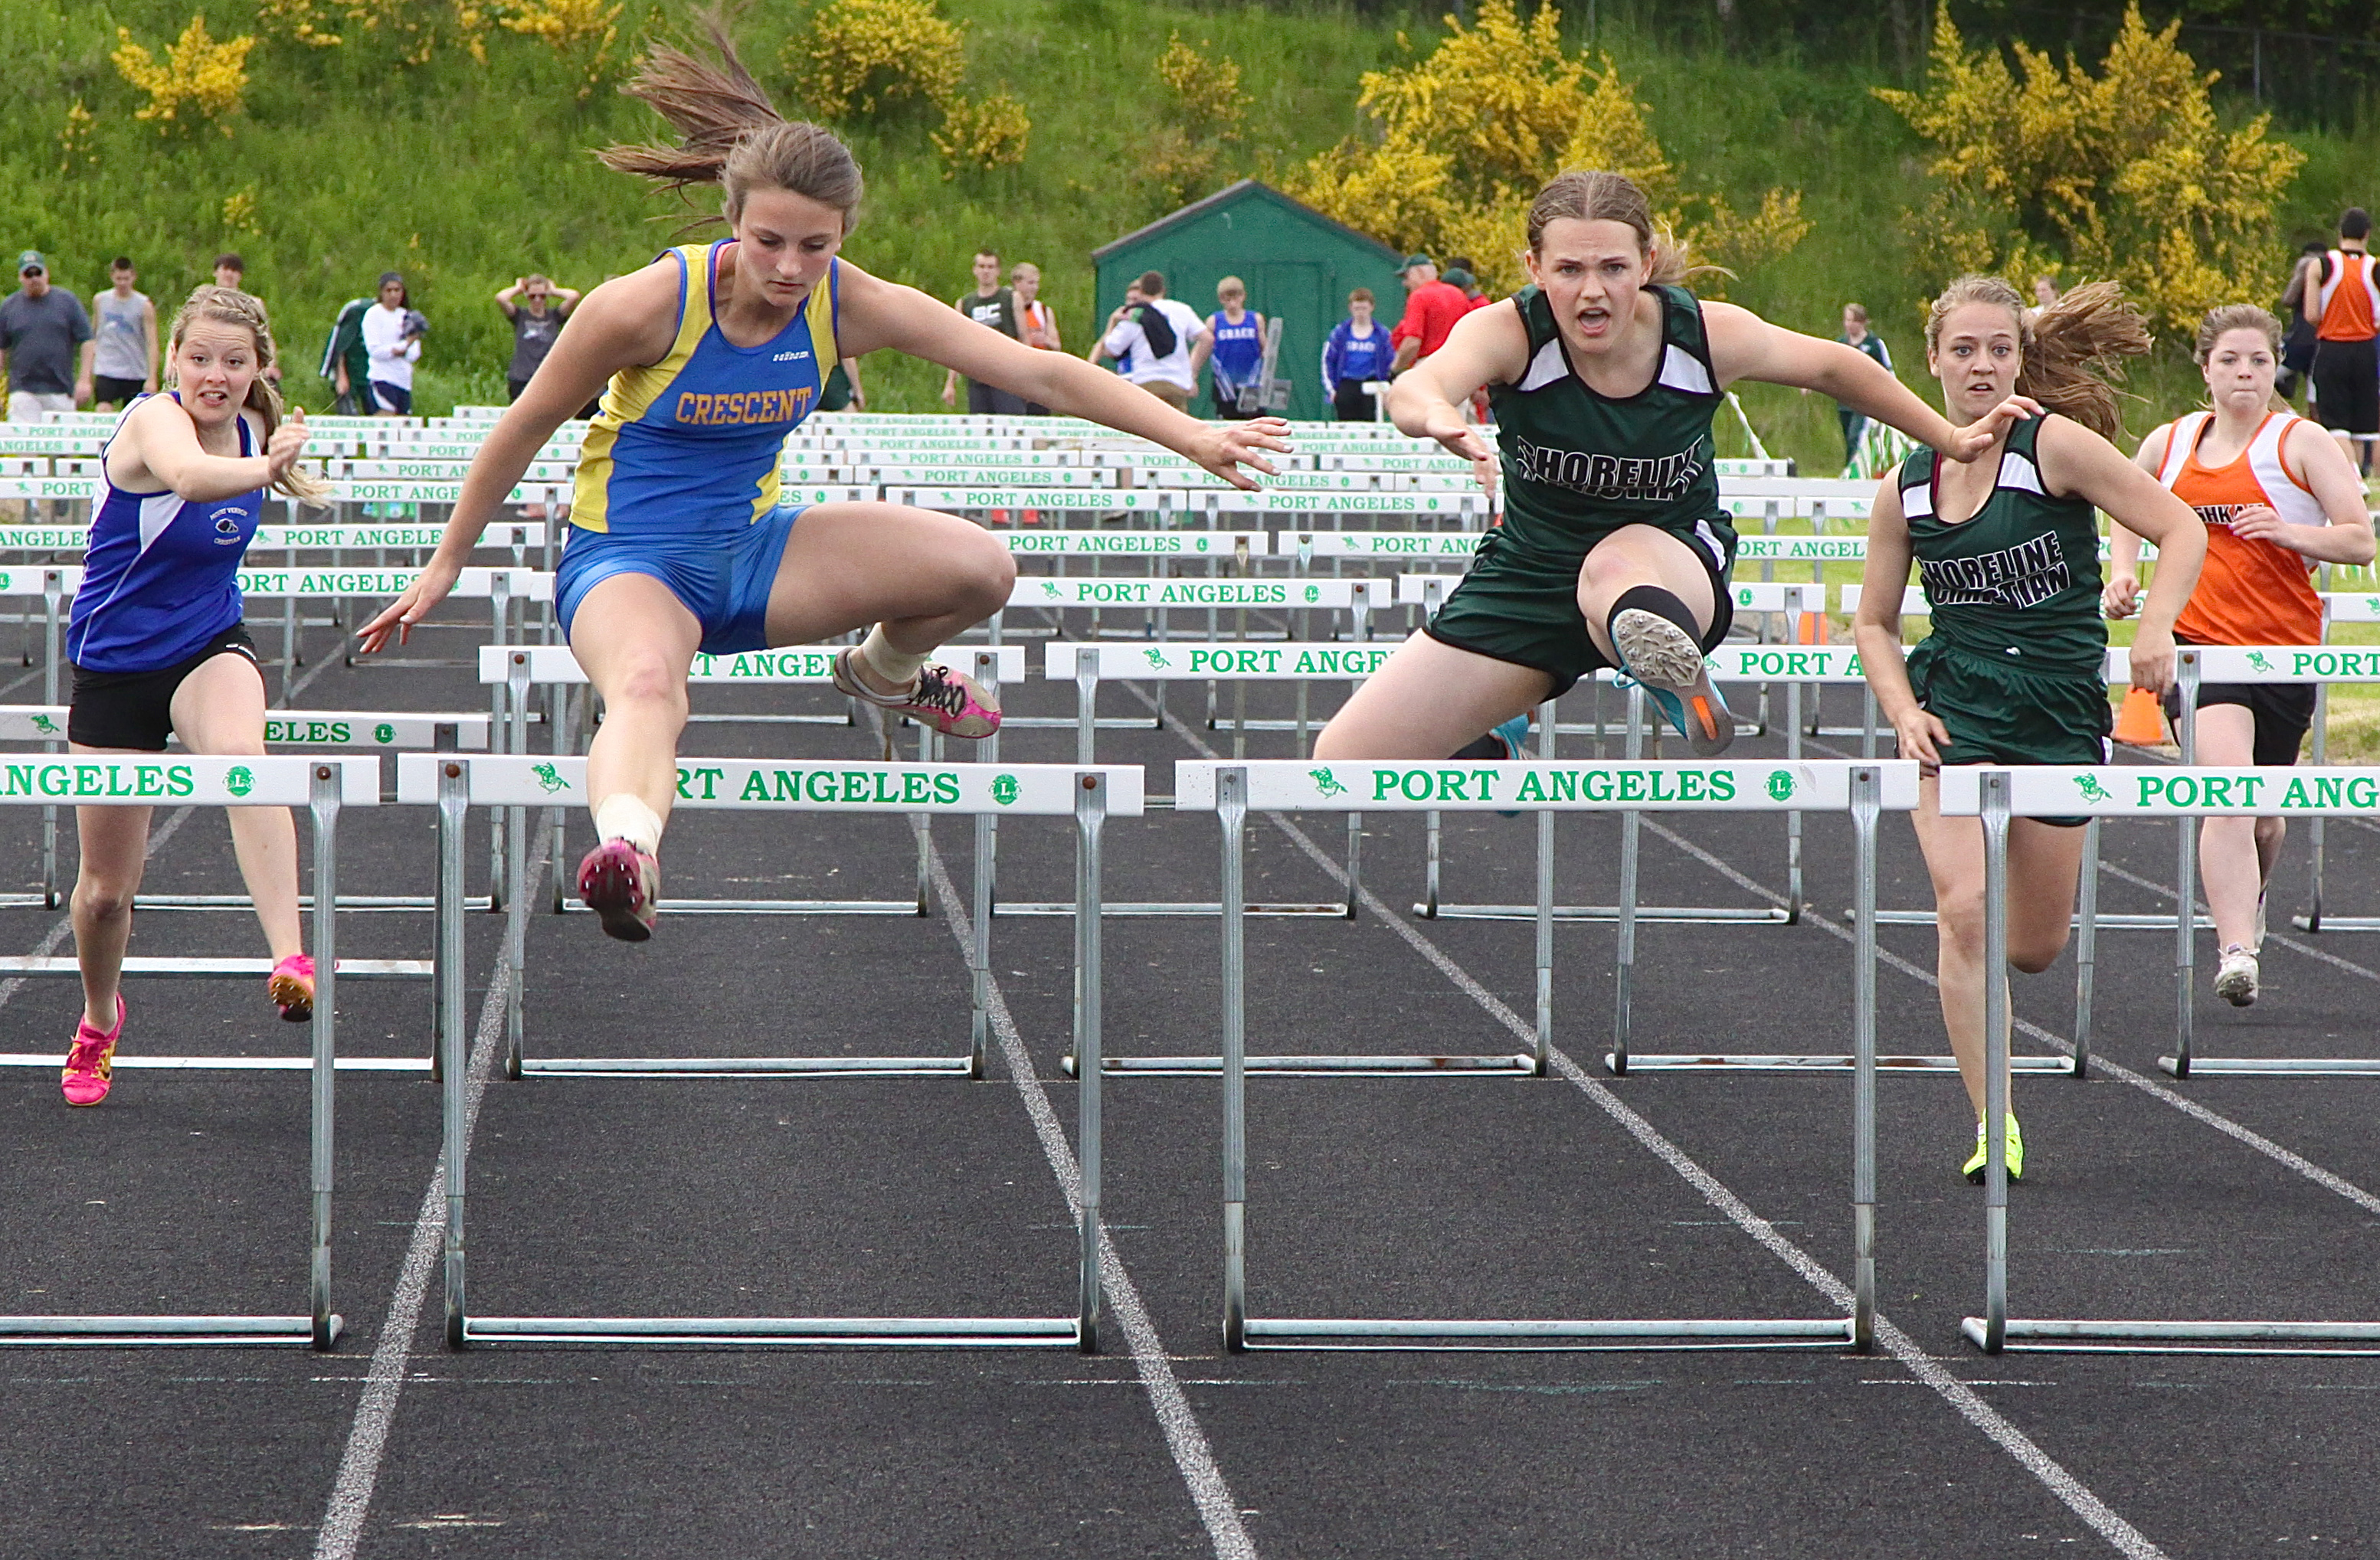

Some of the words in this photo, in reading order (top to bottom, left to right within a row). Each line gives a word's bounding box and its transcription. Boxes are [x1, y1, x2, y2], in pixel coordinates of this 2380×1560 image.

[676, 386, 813, 425] CRESCENT
[30, 427, 66, 436] PORT
[72, 428, 115, 437] ANGEL
[430, 446, 468, 456] PORT
[880, 440, 915, 449] PORT
[921, 440, 982, 450] ANGELES
[1301, 443, 1336, 452] PORT
[1343, 443, 1404, 453] ANGELES
[910, 453, 949, 463] PORT
[955, 454, 1023, 465] ANGELES
[1143, 456, 1181, 466] PORT
[1383, 458, 1420, 469] PORT
[399, 464, 444, 476] PORT
[925, 470, 969, 482] PORT
[975, 471, 1053, 484] ANGELES
[43, 482, 94, 495] PORT
[1255, 475, 1330, 487] ANGELES
[352, 485, 403, 499] PORT
[411, 487, 460, 500] ANGE
[967, 492, 1017, 505] PORT
[1025, 494, 1113, 507] ANGELES
[1269, 495, 1320, 509] PORT
[1327, 497, 1415, 511] ANGELES
[0, 531, 84, 546] ANGELE
[286, 530, 345, 545] PORT
[355, 529, 443, 545] ANGELE
[1010, 536, 1069, 551] PORT
[1079, 537, 1181, 551] ANGELES
[1373, 538, 1432, 552] PORT
[1790, 542, 1864, 557] ANGEL
[235, 574, 289, 594] ORT
[1079, 583, 1150, 601] PORT
[1161, 585, 1285, 602] ANGELES
[731, 654, 836, 676] ANGE
[1191, 650, 1282, 672] PORT
[1295, 651, 1386, 673] ANGE
[1740, 652, 1832, 675] PORT
[266, 721, 352, 742] ELES
[0, 765, 194, 796] NGELES
[741, 770, 960, 803] ANGELES
[1373, 770, 1499, 800] PORT
[1517, 770, 1735, 801] ANGELES
[2137, 777, 2264, 807] PORT
